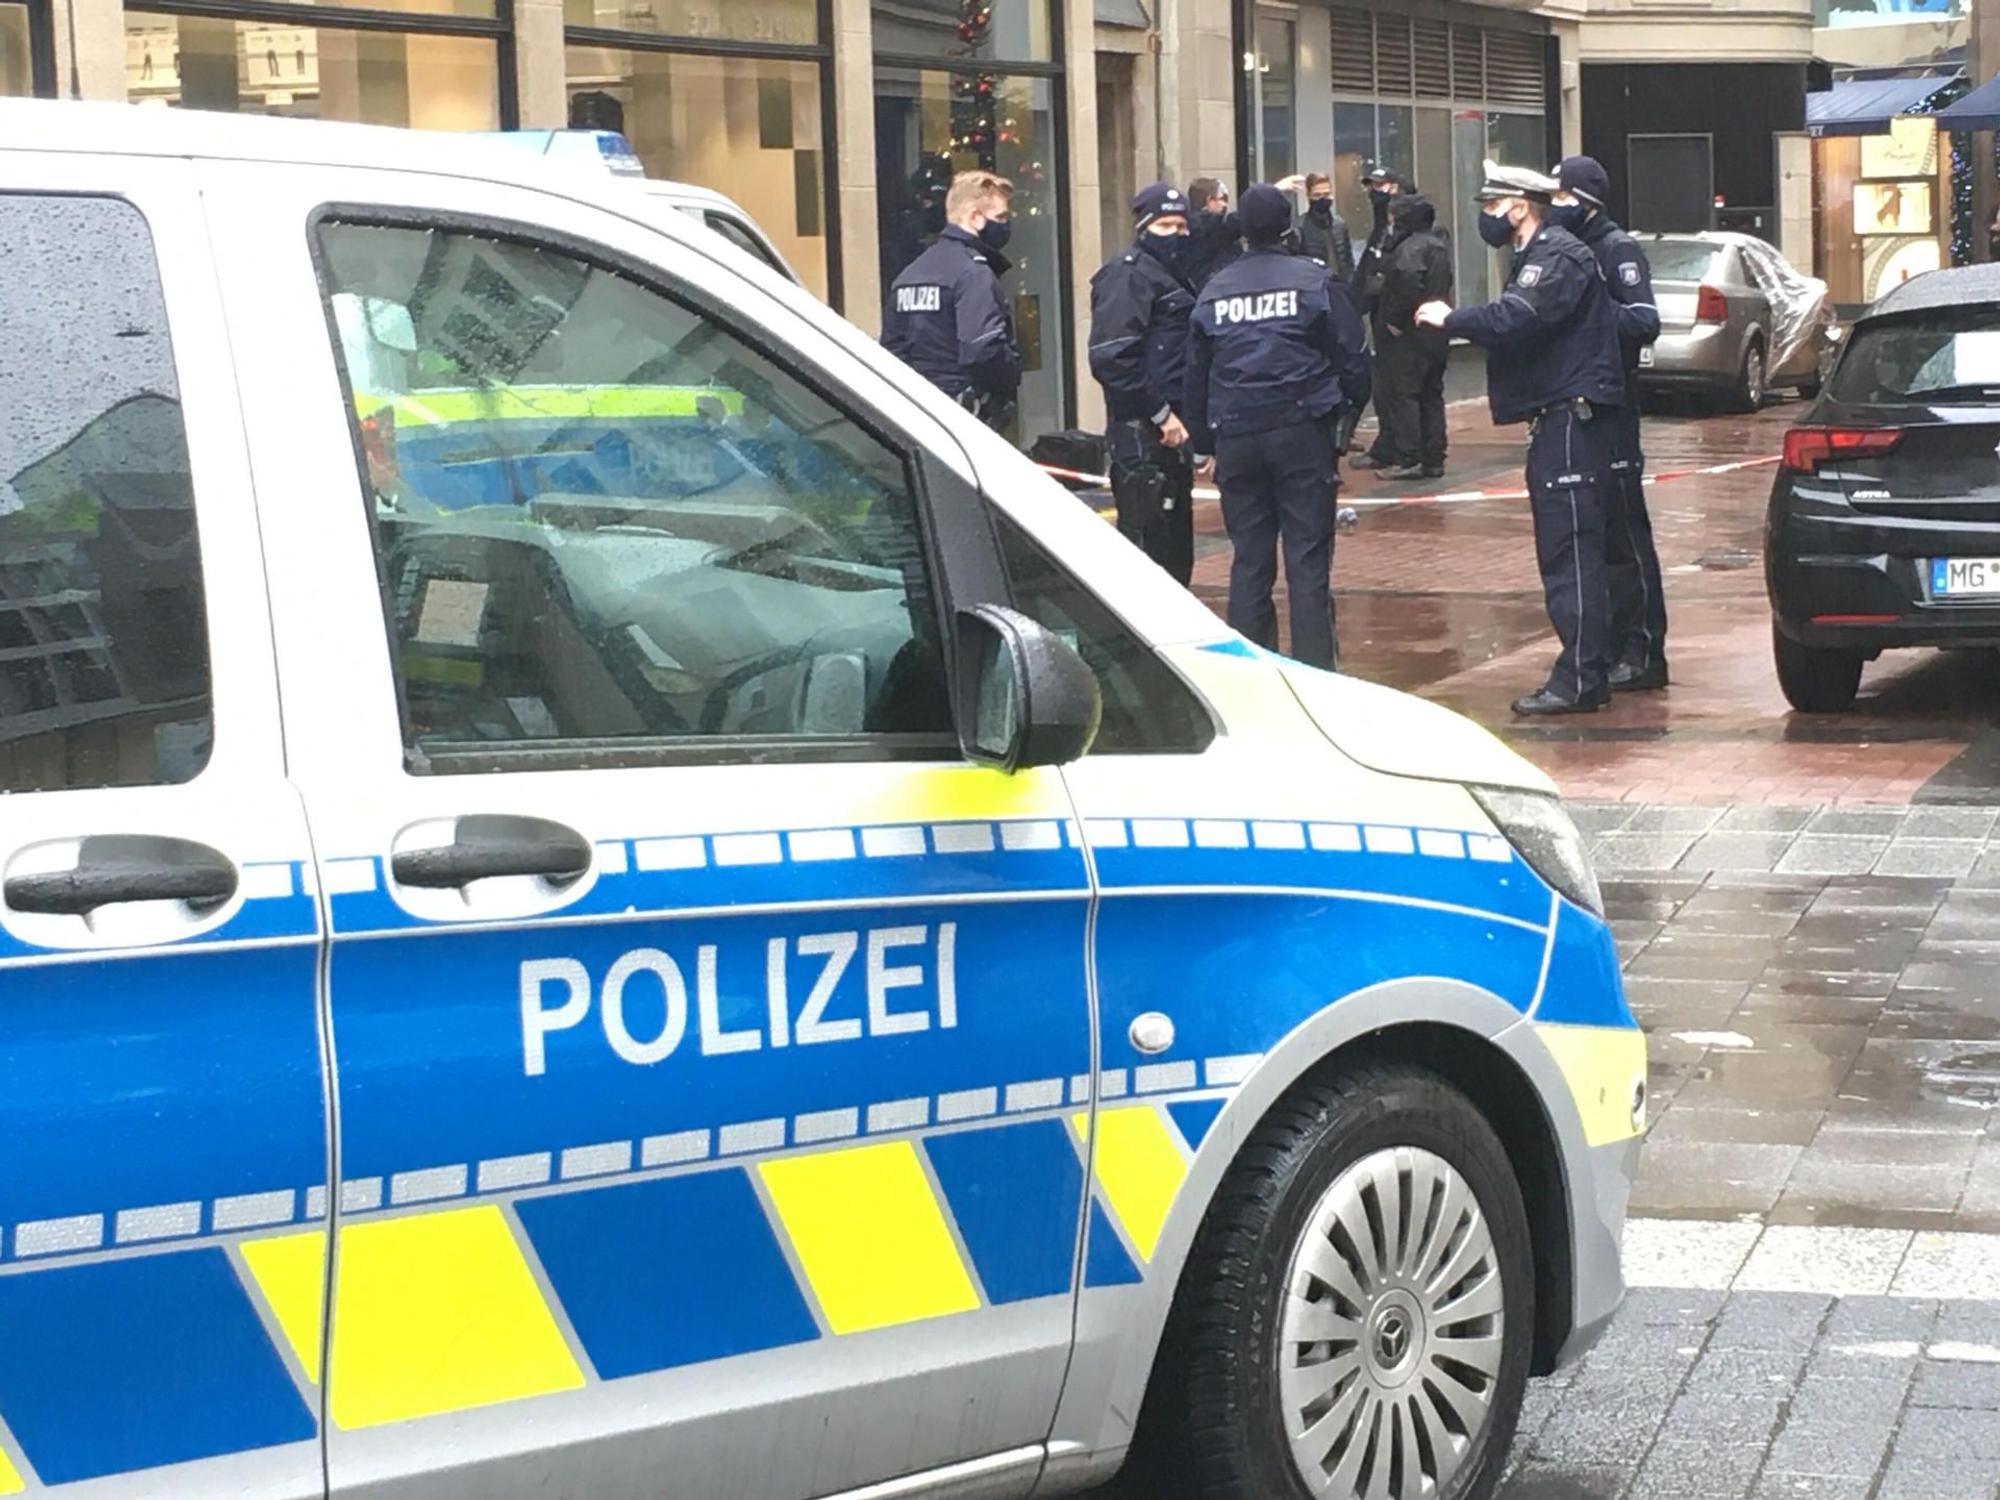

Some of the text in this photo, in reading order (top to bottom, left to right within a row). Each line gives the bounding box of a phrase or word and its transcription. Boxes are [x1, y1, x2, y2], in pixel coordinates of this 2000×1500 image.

[897, 286, 940, 312] POLIZEI
[1214, 290, 1298, 325] POLIZEI
[1950, 562, 1985, 588] MG
[520, 922, 957, 1077] POLIZEI
